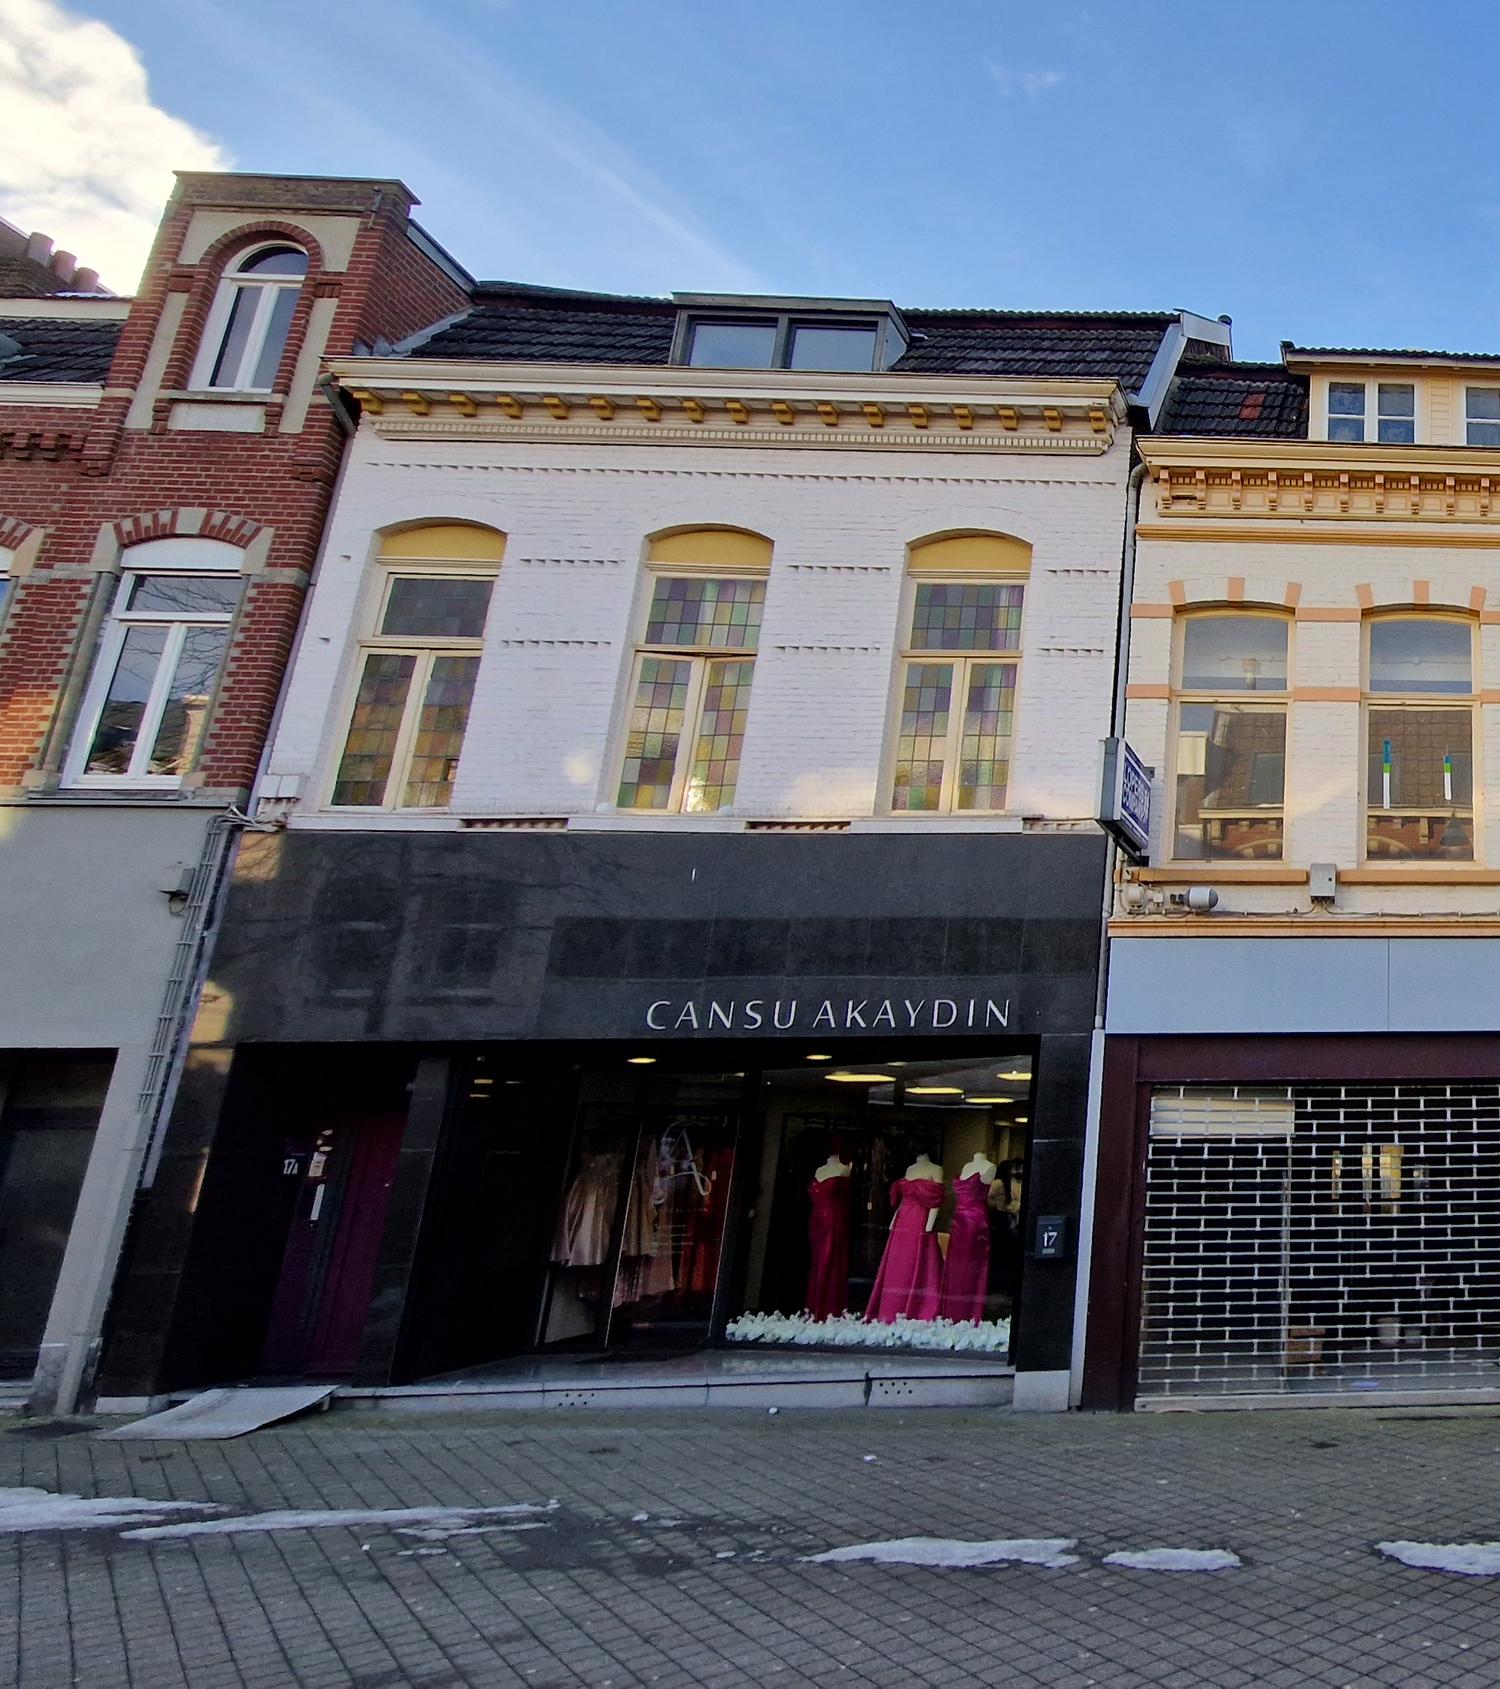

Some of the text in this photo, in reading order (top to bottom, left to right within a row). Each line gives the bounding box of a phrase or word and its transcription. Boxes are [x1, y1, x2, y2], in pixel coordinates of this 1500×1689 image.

[646, 999, 1010, 1030] CANSU AKAYDIN
[1043, 1231, 1058, 1247] 17
